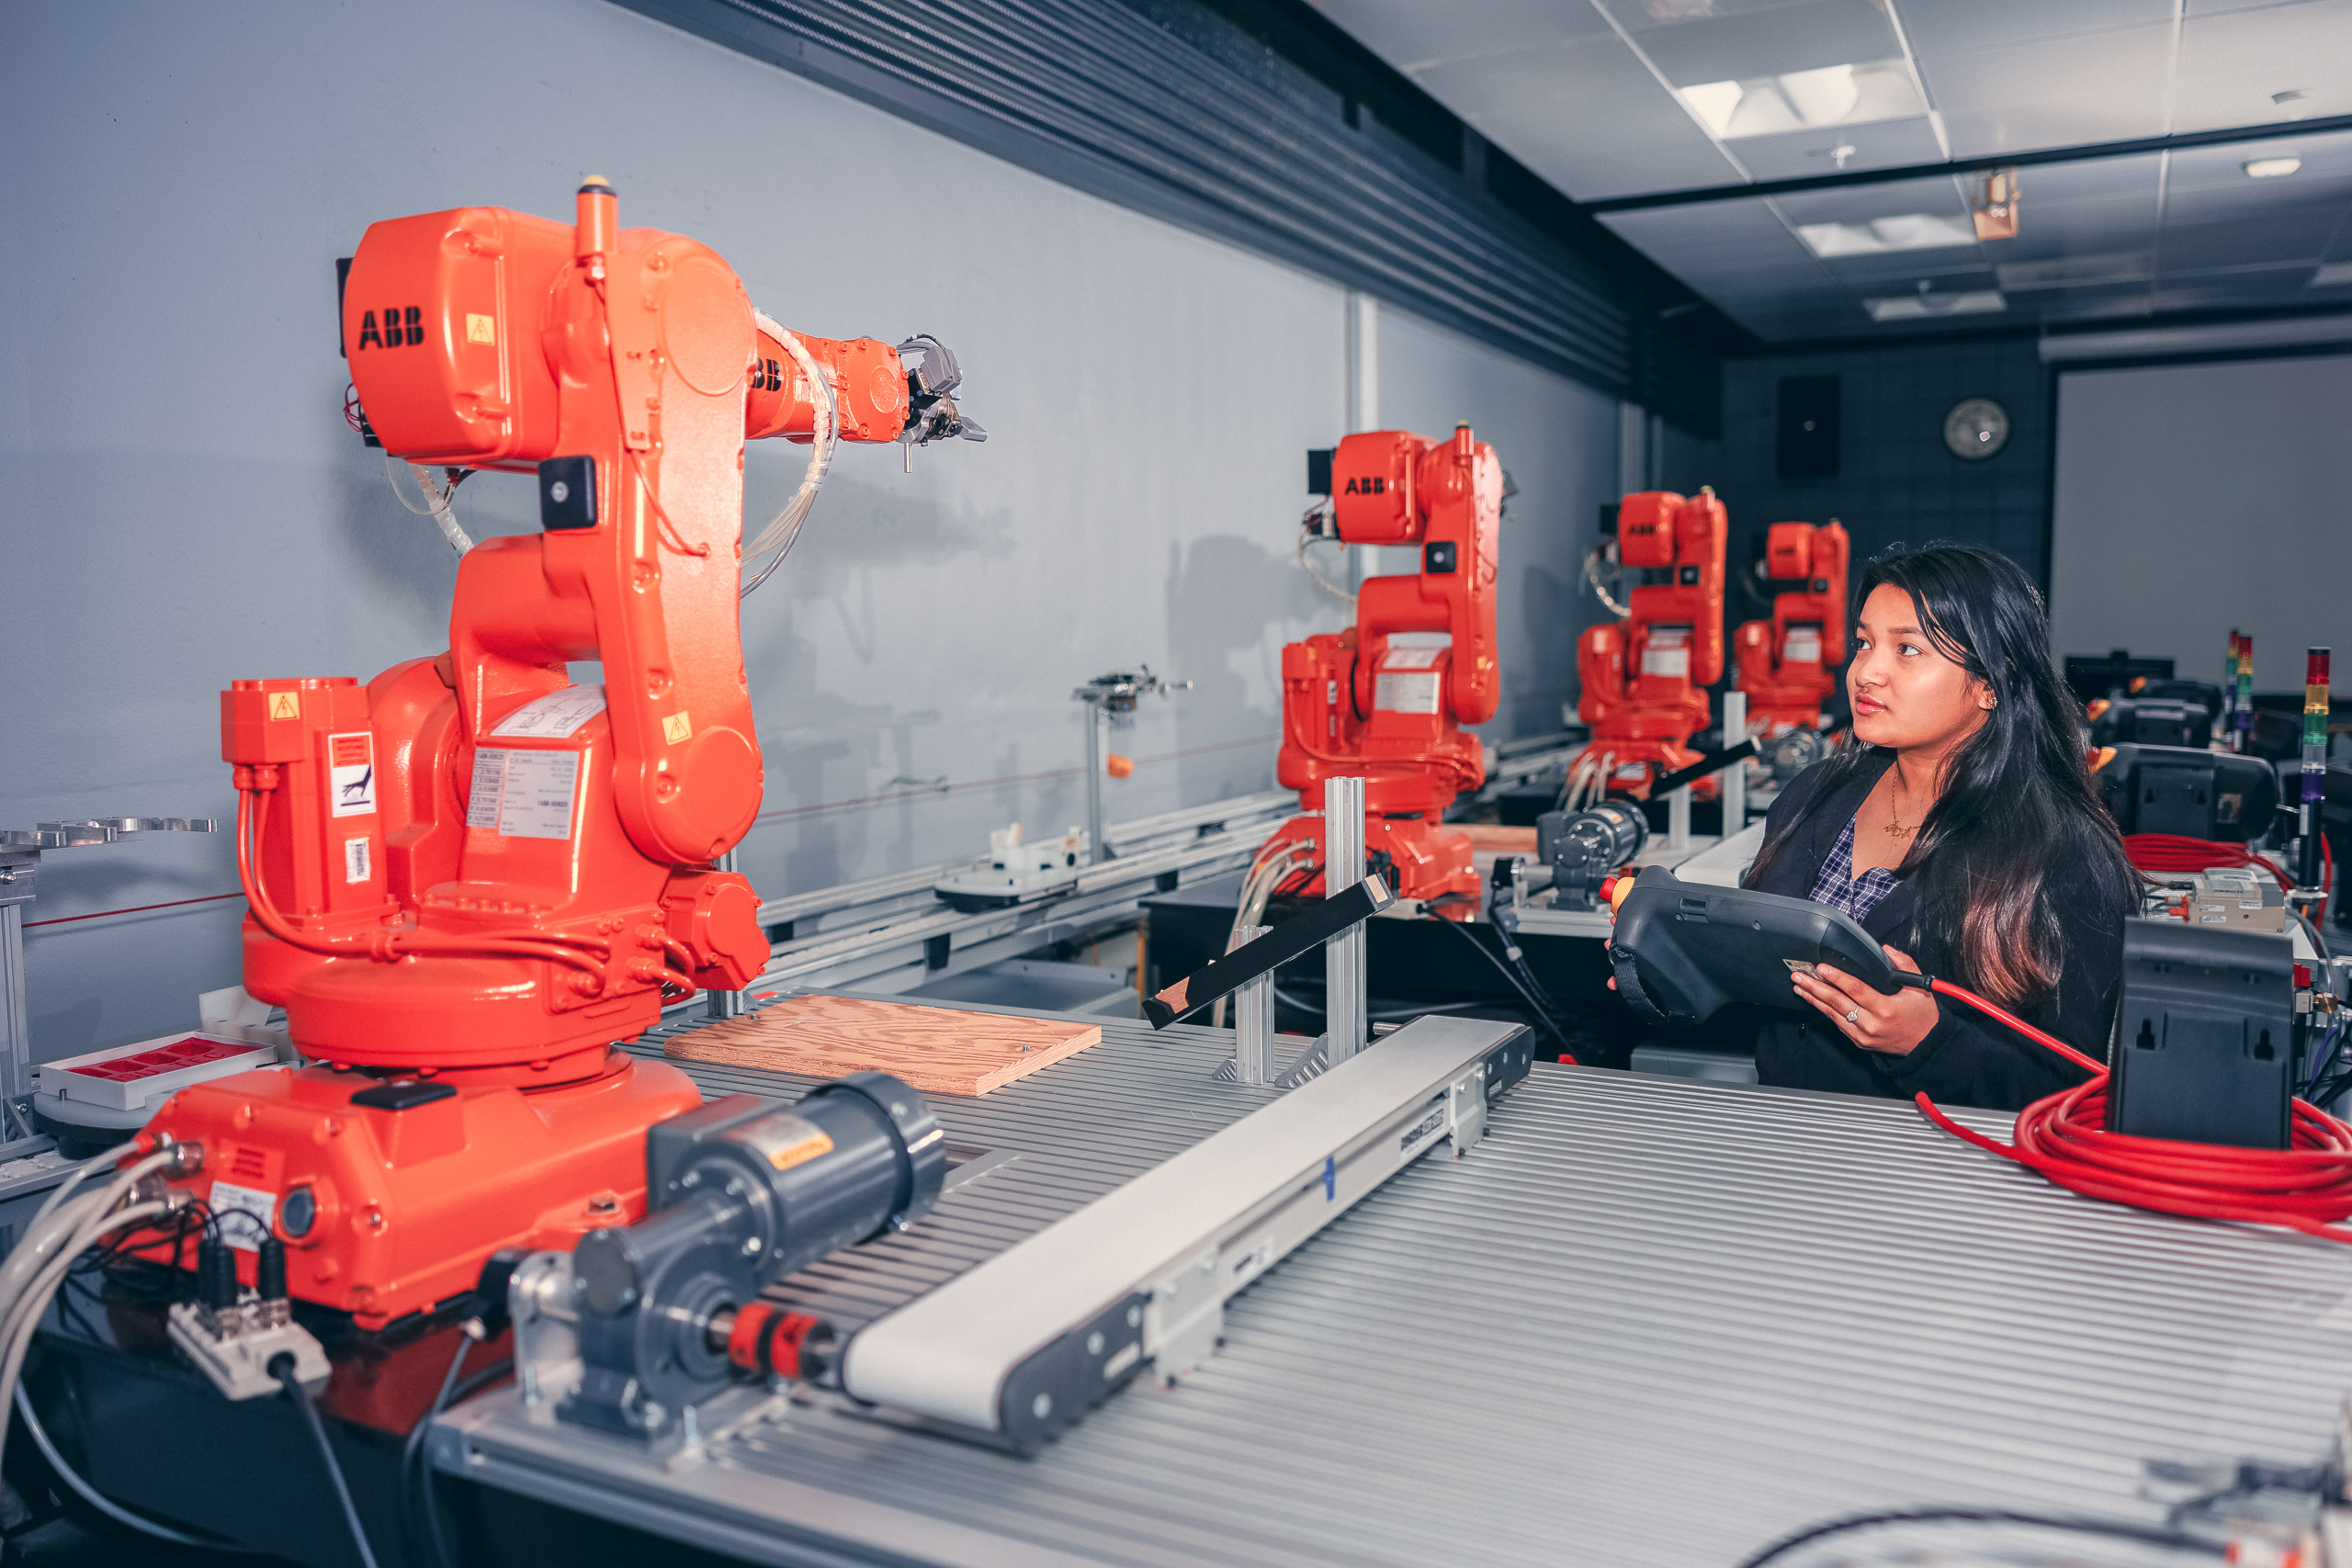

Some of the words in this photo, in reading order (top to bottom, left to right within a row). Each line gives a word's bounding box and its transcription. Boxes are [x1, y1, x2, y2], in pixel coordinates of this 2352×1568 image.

[358, 306, 424, 351] ABB
[752, 357, 782, 392] BB
[1345, 477, 1385, 495] ABB
